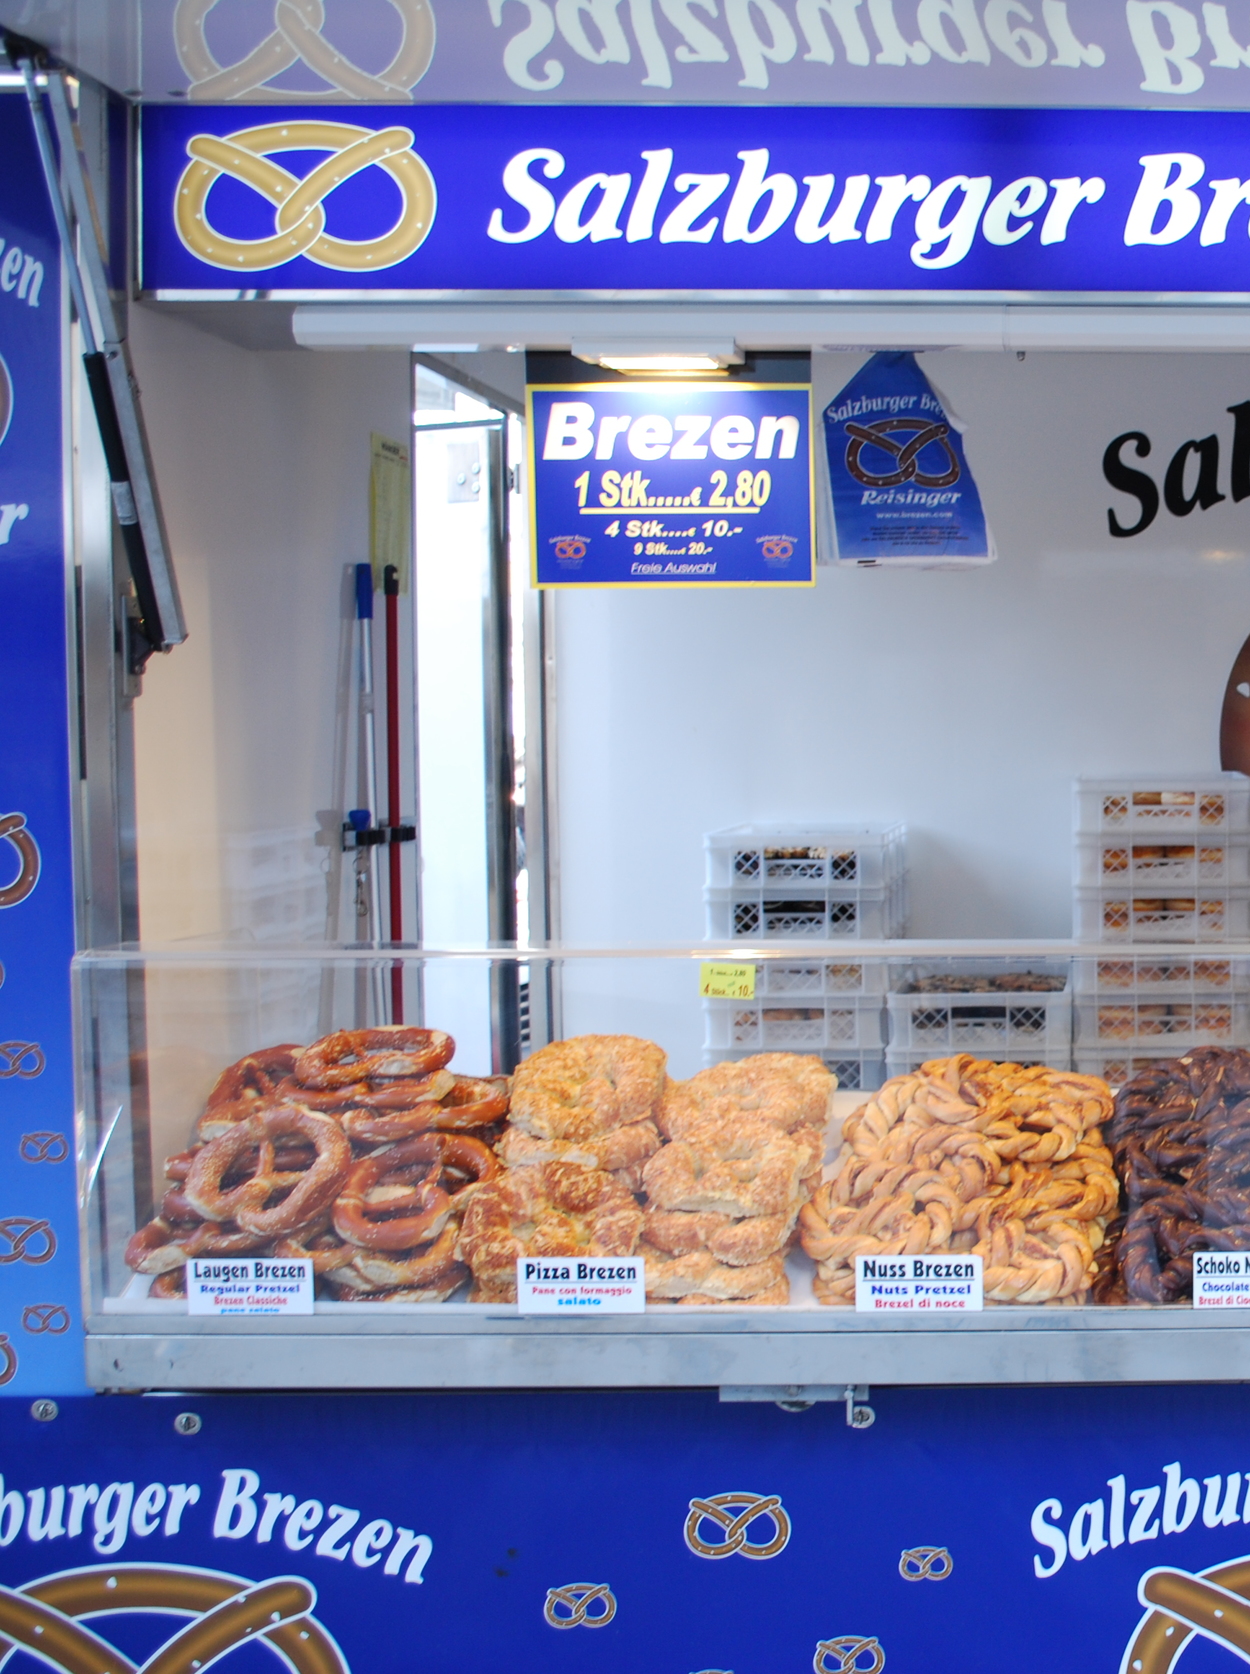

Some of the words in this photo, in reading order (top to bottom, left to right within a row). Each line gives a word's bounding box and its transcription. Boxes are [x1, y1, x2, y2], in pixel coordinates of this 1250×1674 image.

[487, 147, 1106, 270] Salzburger
[826, 394, 917, 424] Salzburger
[543, 401, 800, 461] Brezen
[574, 471, 591, 507] 1
[709, 470, 771, 509] 2,80
[861, 489, 962, 508] Reisinger
[604, 520, 620, 538] 4
[634, 542, 643, 555] 9
[631, 562, 663, 575] Freie
[664, 561, 717, 574] Auswahl
[194, 1262, 249, 1283] Laugen
[255, 1262, 305, 1278] Brezen
[525, 1261, 570, 1280] Pizza
[577, 1263, 636, 1280] Brezen
[863, 1260, 906, 1278] Nuss
[913, 1260, 974, 1278] Brezen
[1197, 1256, 1240, 1275] Schoko
[201, 1284, 250, 1295] Regular
[255, 1284, 300, 1293] Pretzel
[532, 1286, 555, 1295] Pane
[559, 1287, 577, 1295] con
[580, 1286, 632, 1297] formaggio
[871, 1285, 908, 1295] Nuts
[915, 1284, 971, 1295] Pretzel
[1202, 1281, 1249, 1292] Chocolate
[558, 1297, 601, 1306] salato
[875, 1299, 914, 1308] Brezel
[918, 1298, 931, 1308] di
[935, 1300, 965, 1308] noce
[1199, 1296, 1223, 1305] Brezel
[1226, 1296, 1234, 1305] di
[213, 1468, 434, 1585] Brezen
